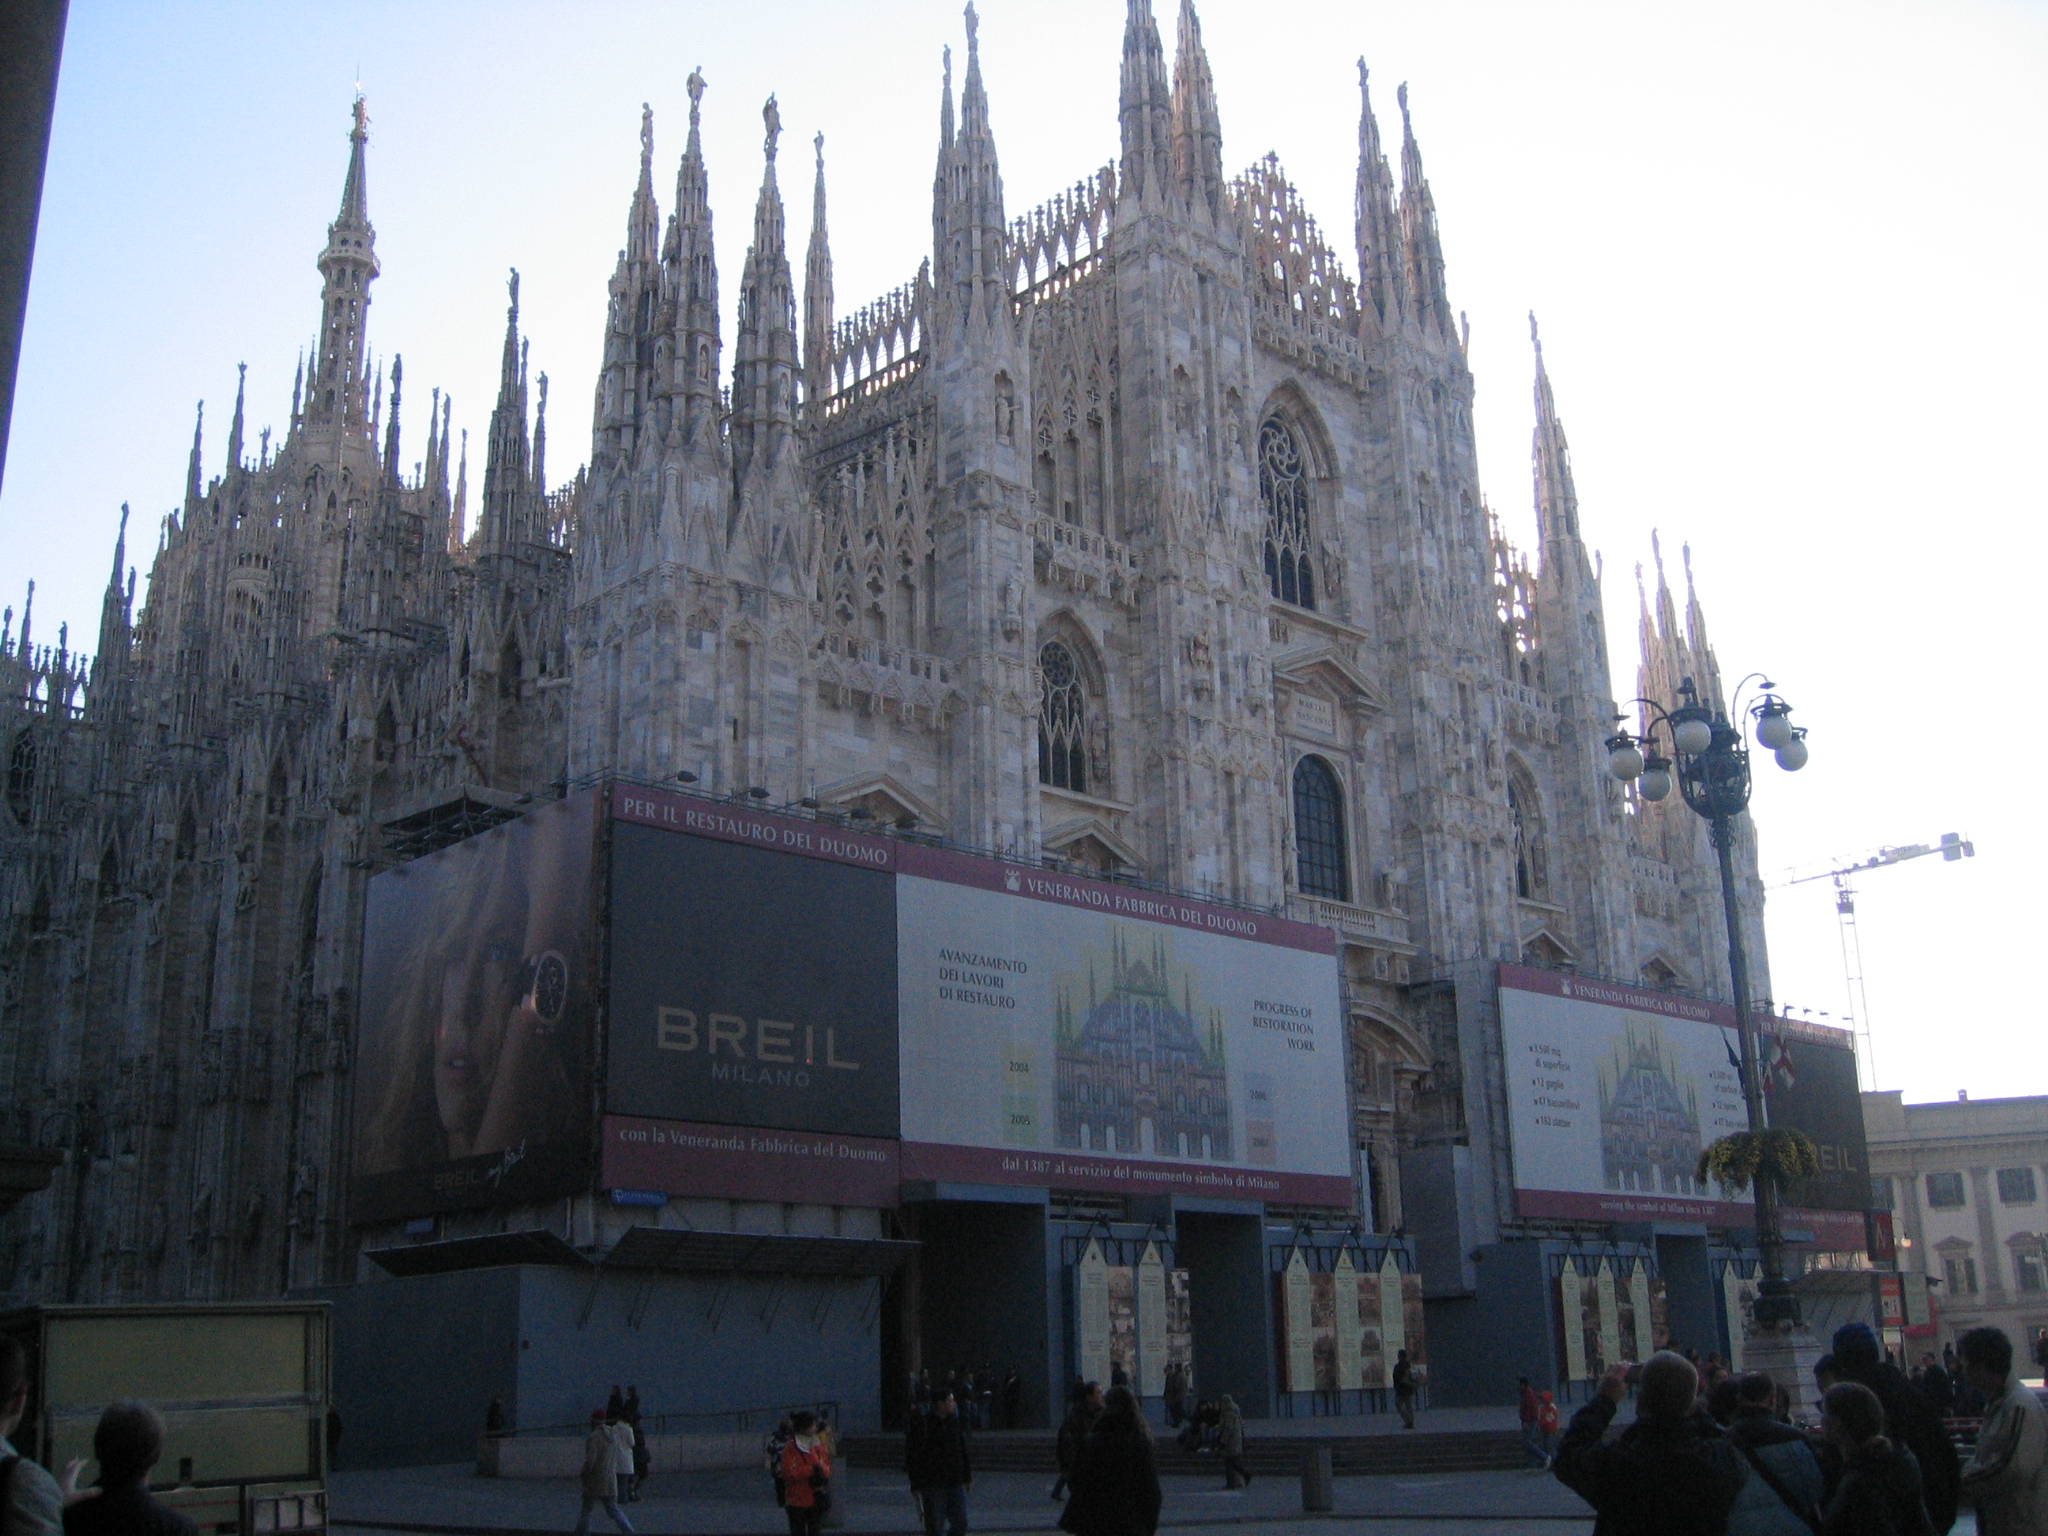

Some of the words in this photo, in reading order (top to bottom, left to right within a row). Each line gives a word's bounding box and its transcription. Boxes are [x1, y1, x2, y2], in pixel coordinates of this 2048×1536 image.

[624, 797, 656, 818] PER
[663, 805, 678, 823] IL
[686, 809, 776, 842] RESTAURO
[783, 830, 814, 850] DEL
[820, 837, 888, 865] DUOMO
[1028, 878, 1111, 907] VENERANDA
[1115, 895, 1177, 920] FABBRICA
[1181, 908, 1203, 926] DEL
[1207, 914, 1257, 935] DUOMO
[939, 948, 1027, 974] AVANZAMENTO
[939, 967, 958, 981] DEI
[962, 971, 1004, 989] LAVORI
[939, 986, 953, 1000] DI
[957, 989, 1015, 1009] RESTAURO
[1254, 1000, 1299, 1018] PROGRESS
[1301, 1006, 1312, 1019] OF
[1575, 984, 1623, 1004] VENERANDA
[1625, 994, 1662, 1010] FABBRICA
[1664, 1002, 1677, 1013] DEL
[1680, 1004, 1710, 1019] DUOMO
[658, 1006, 860, 1070] BREIL
[1253, 1016, 1314, 1035] RESTORATION
[1287, 1038, 1316, 1052] WORK
[712, 1062, 810, 1087] MILANO
[1010, 1061, 1029, 1073] 2004
[620, 1129, 647, 1142] con
[652, 1127, 665, 1144] la
[670, 1131, 745, 1151] Veneranda
[750, 1137, 808, 1156] Fabbrica
[813, 1142, 833, 1157] del
[839, 1144, 886, 1162] Duomo
[434, 1168, 480, 1190] BREIL
[1002, 1157, 1019, 1171] dal
[1025, 1158, 1050, 1173] 1387
[1055, 1162, 1066, 1175] al
[1069, 1164, 1110, 1178] servizio
[1113, 1166, 1130, 1179] del
[1133, 1170, 1192, 1183] monumento
[1195, 1170, 1233, 1187] simbolo
[1235, 1174, 1245, 1187] di
[1249, 1174, 1280, 1190] Milano
